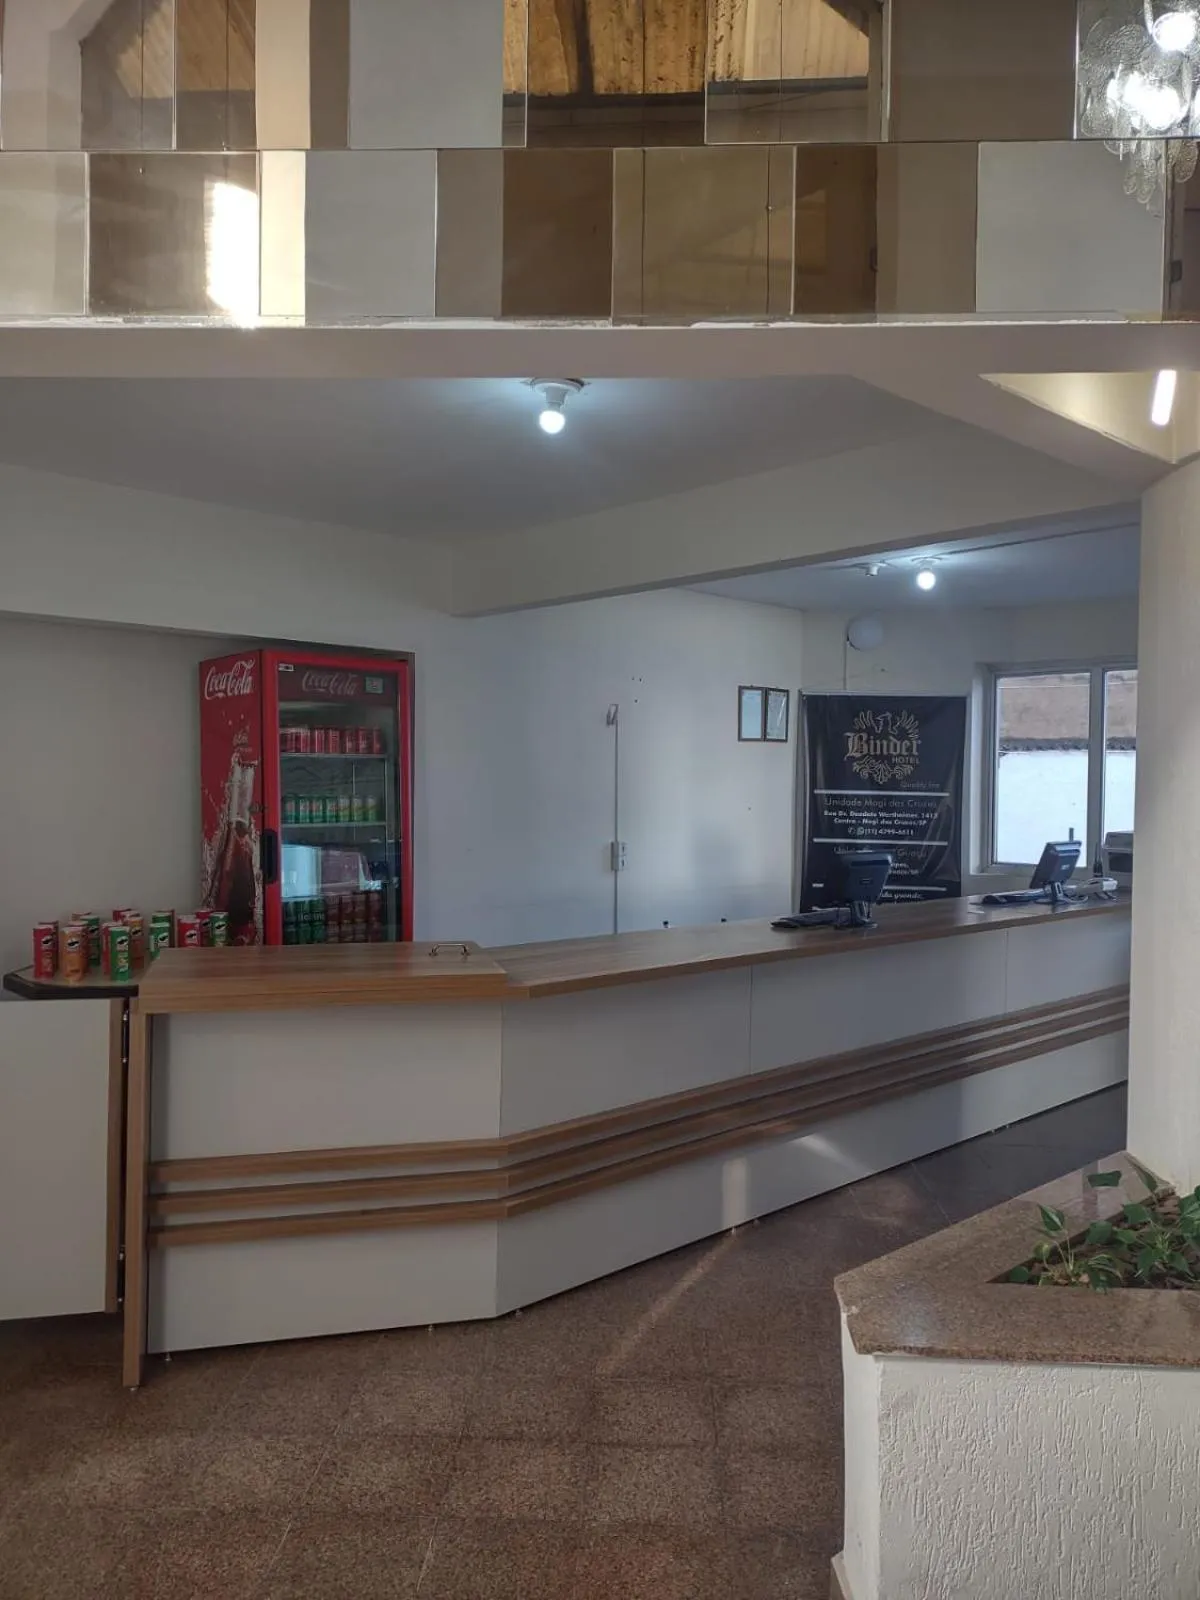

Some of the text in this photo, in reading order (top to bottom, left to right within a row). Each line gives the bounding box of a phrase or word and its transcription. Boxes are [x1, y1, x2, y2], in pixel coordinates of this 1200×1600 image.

[843, 732, 922, 761] Binder
[891, 756, 920, 764] HOTEL
[823, 797, 862, 806] Unidade
